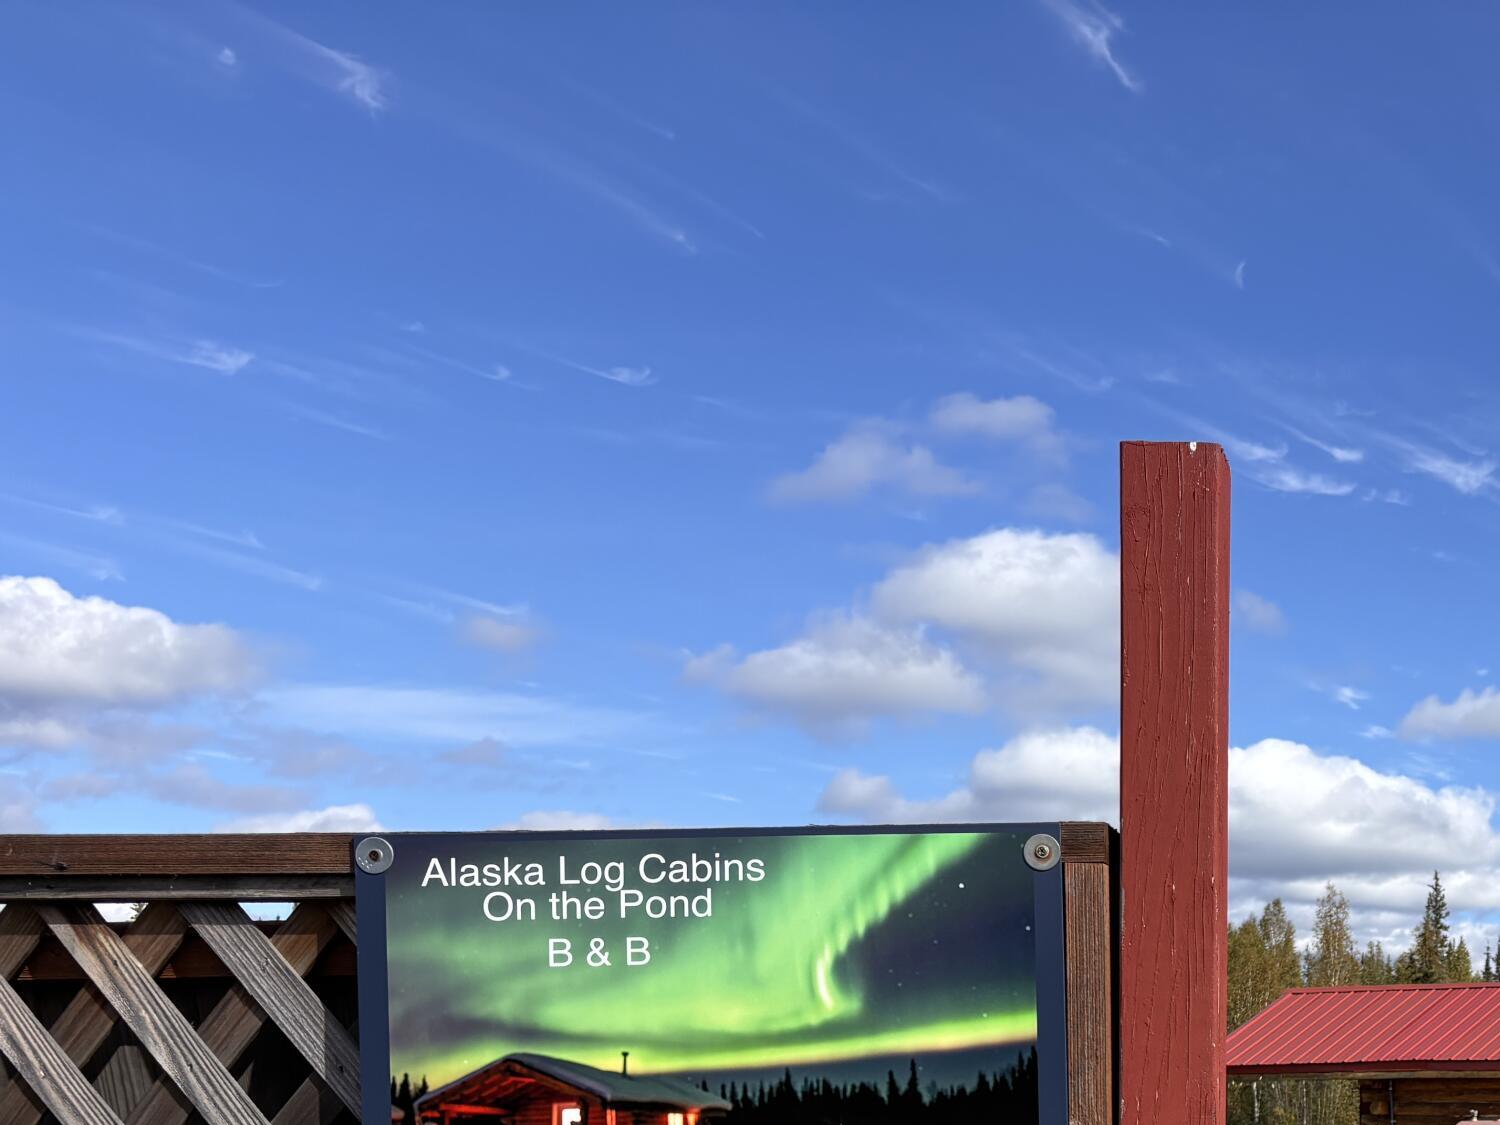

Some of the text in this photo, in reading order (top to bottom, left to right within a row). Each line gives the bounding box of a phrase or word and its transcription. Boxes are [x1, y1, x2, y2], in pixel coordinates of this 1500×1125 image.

[421, 852, 766, 892] Alaska Log Cabins
[483, 888, 713, 922] On the Pond
[548, 936, 651, 968] B & B
